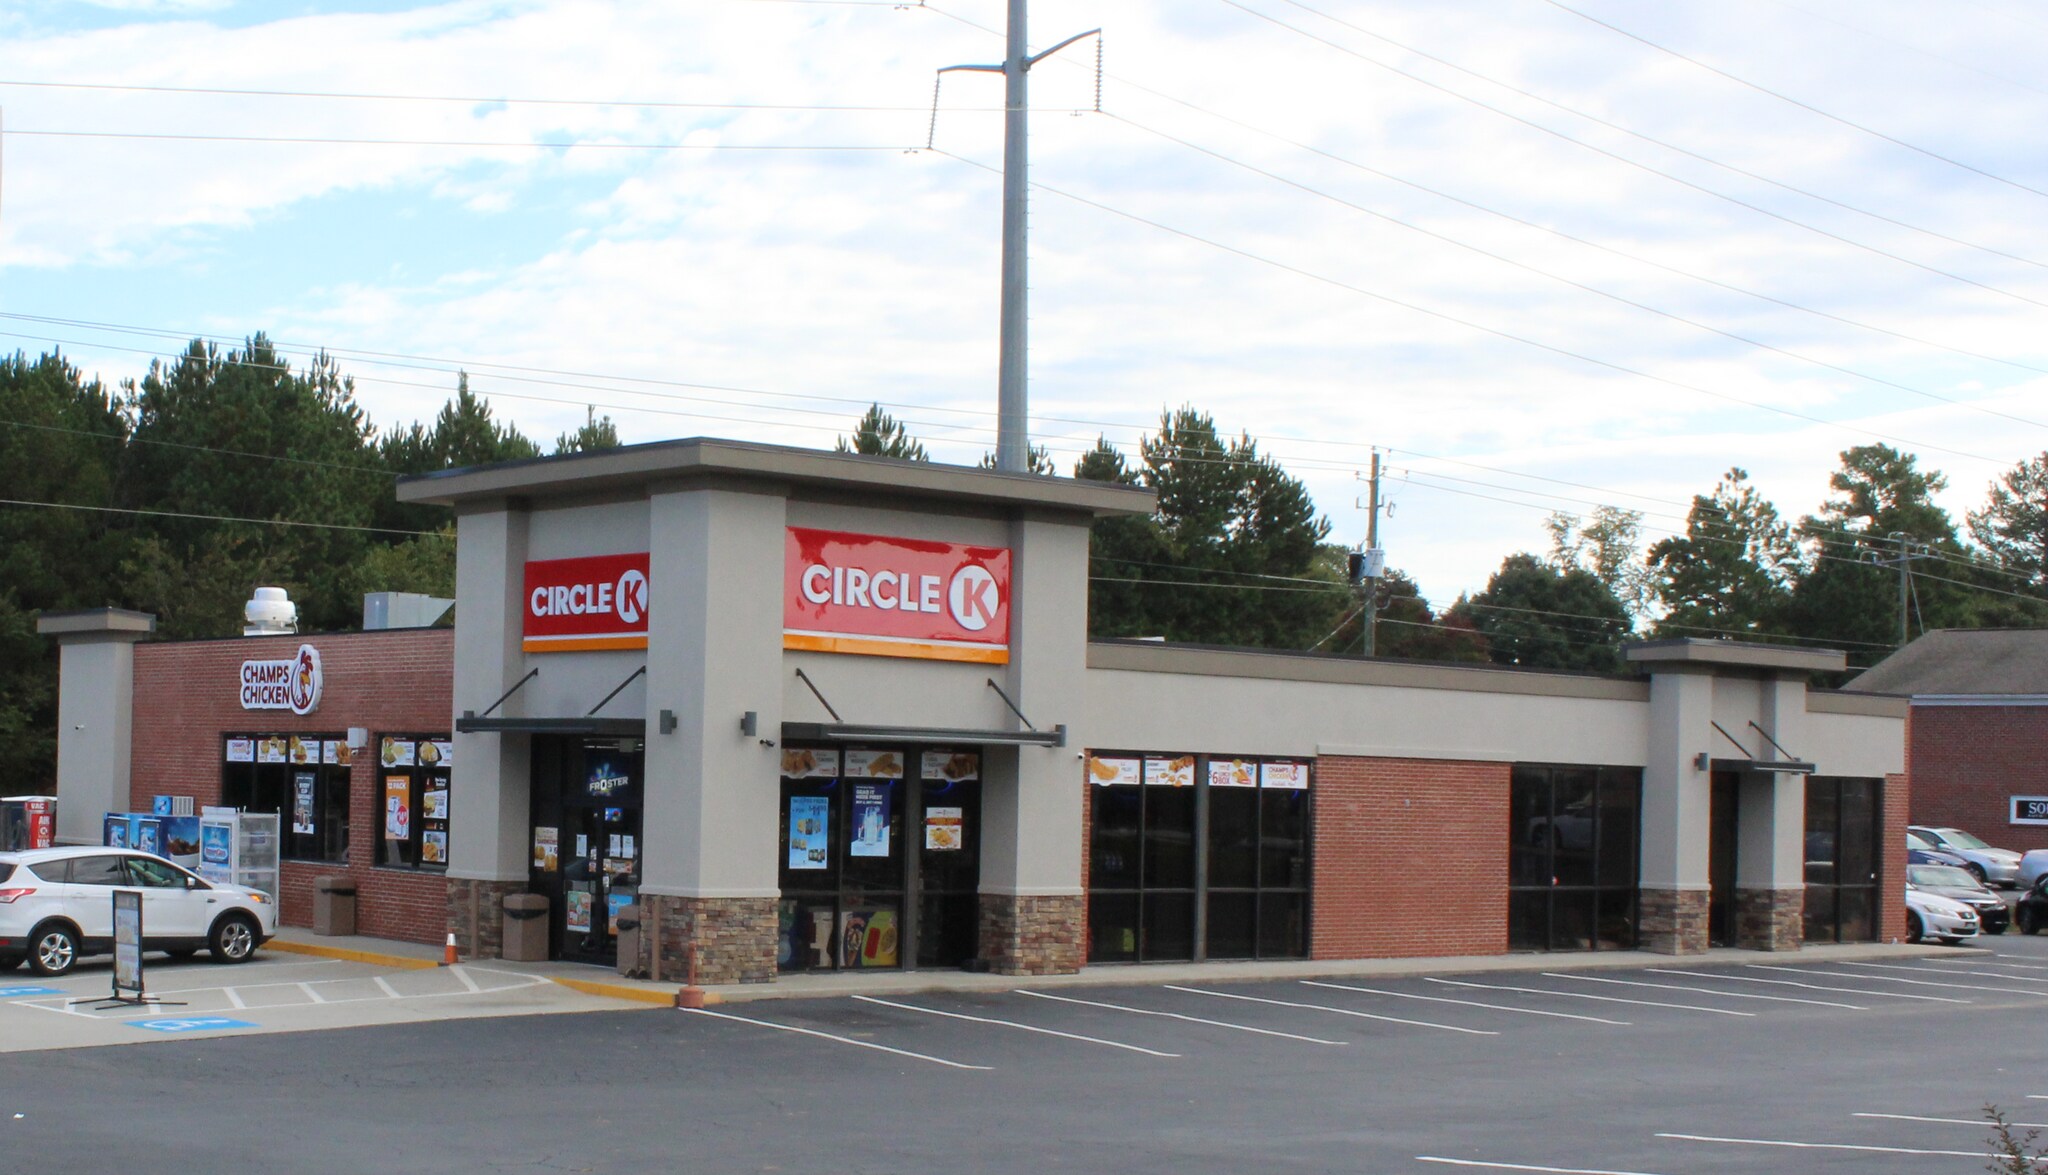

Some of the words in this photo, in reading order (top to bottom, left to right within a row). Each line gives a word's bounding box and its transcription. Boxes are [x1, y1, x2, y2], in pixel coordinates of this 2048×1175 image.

[531, 582, 612, 617] CIRCLE
[621, 574, 648, 622] K
[802, 563, 941, 614] CIRCLE
[955, 570, 997, 628] K
[243, 665, 290, 684] CHAMPS
[243, 685, 290, 705] CHICKEN
[393, 782, 406, 790] PACK
[589, 776, 628, 792] FROSTER
[1218, 777, 1231, 785] BOX
[39, 815, 50, 825] AIR
[36, 838, 50, 848] VAC
